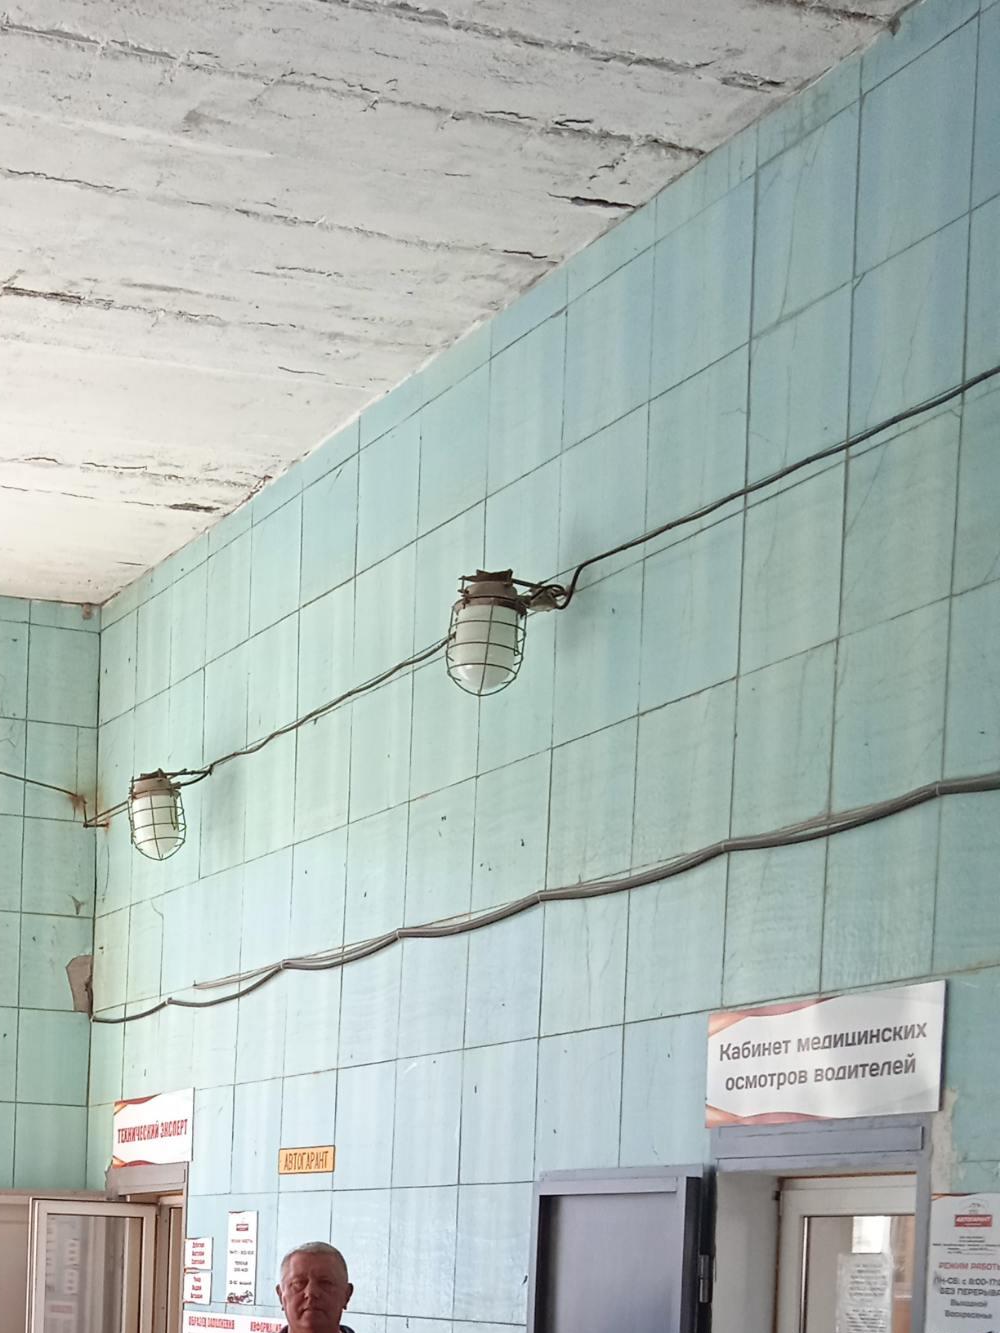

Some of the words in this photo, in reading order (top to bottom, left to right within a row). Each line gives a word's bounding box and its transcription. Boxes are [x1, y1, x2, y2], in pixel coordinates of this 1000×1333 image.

[719, 1040, 791, 1061] Кабинет
[797, 1022, 928, 1053] медицинских
[725, 1069, 808, 1091] осмотров
[814, 1053, 916, 1083] водителей
[117, 1120, 159, 1144] ТЕХНИЧЕСКИЙ
[160, 1118, 188, 1138] ЭКСПЕРТ
[284, 1151, 329, 1171] АВТОГАРАНТ
